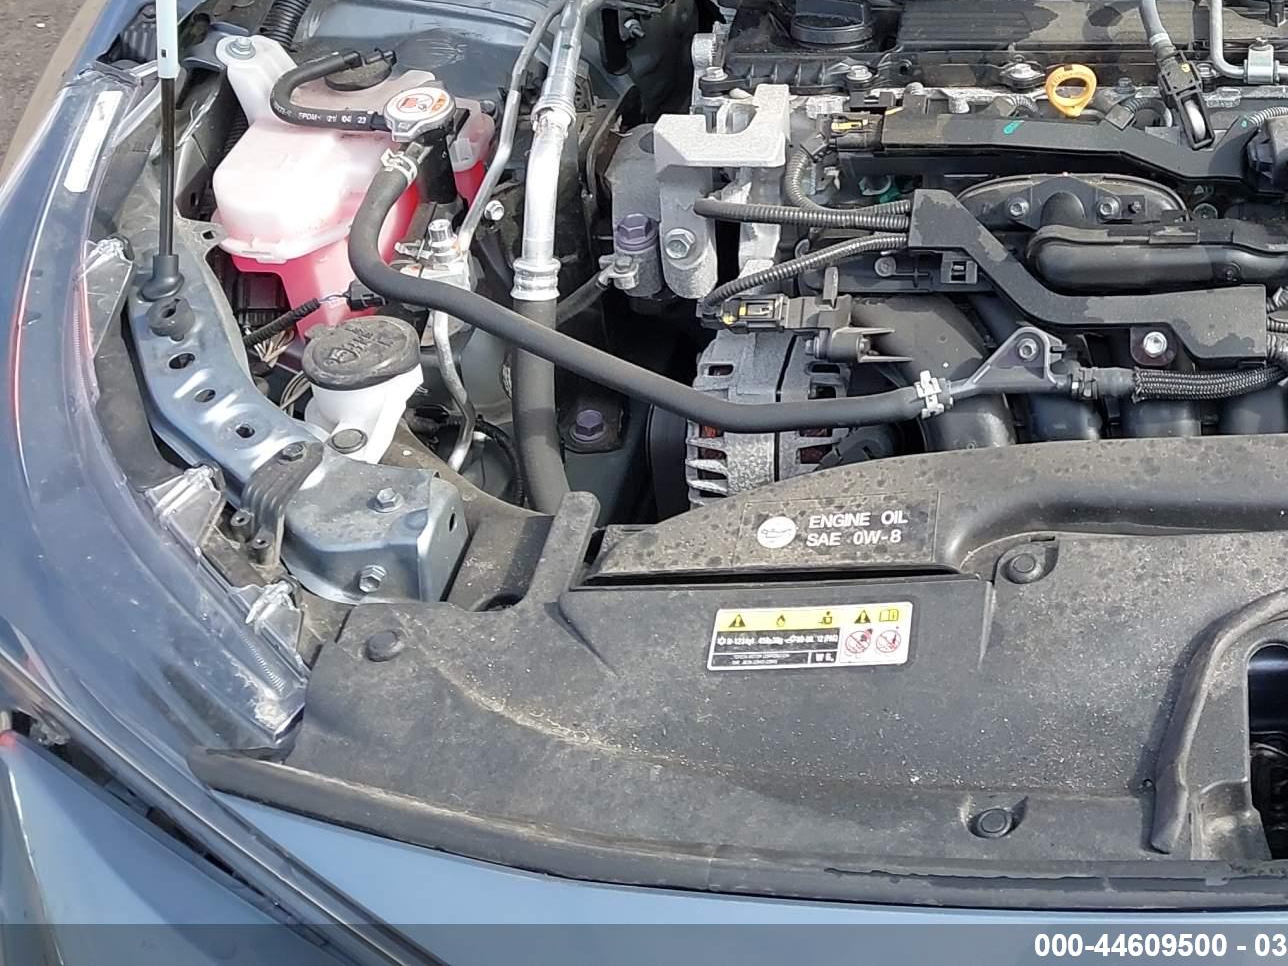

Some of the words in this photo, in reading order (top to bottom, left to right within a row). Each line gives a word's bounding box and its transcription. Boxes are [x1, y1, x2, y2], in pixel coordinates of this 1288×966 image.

[808, 512, 871, 529] ENGINE
[881, 510, 909, 525] OIL
[806, 532, 842, 547] SAE
[852, 529, 902, 546] 0W-8
